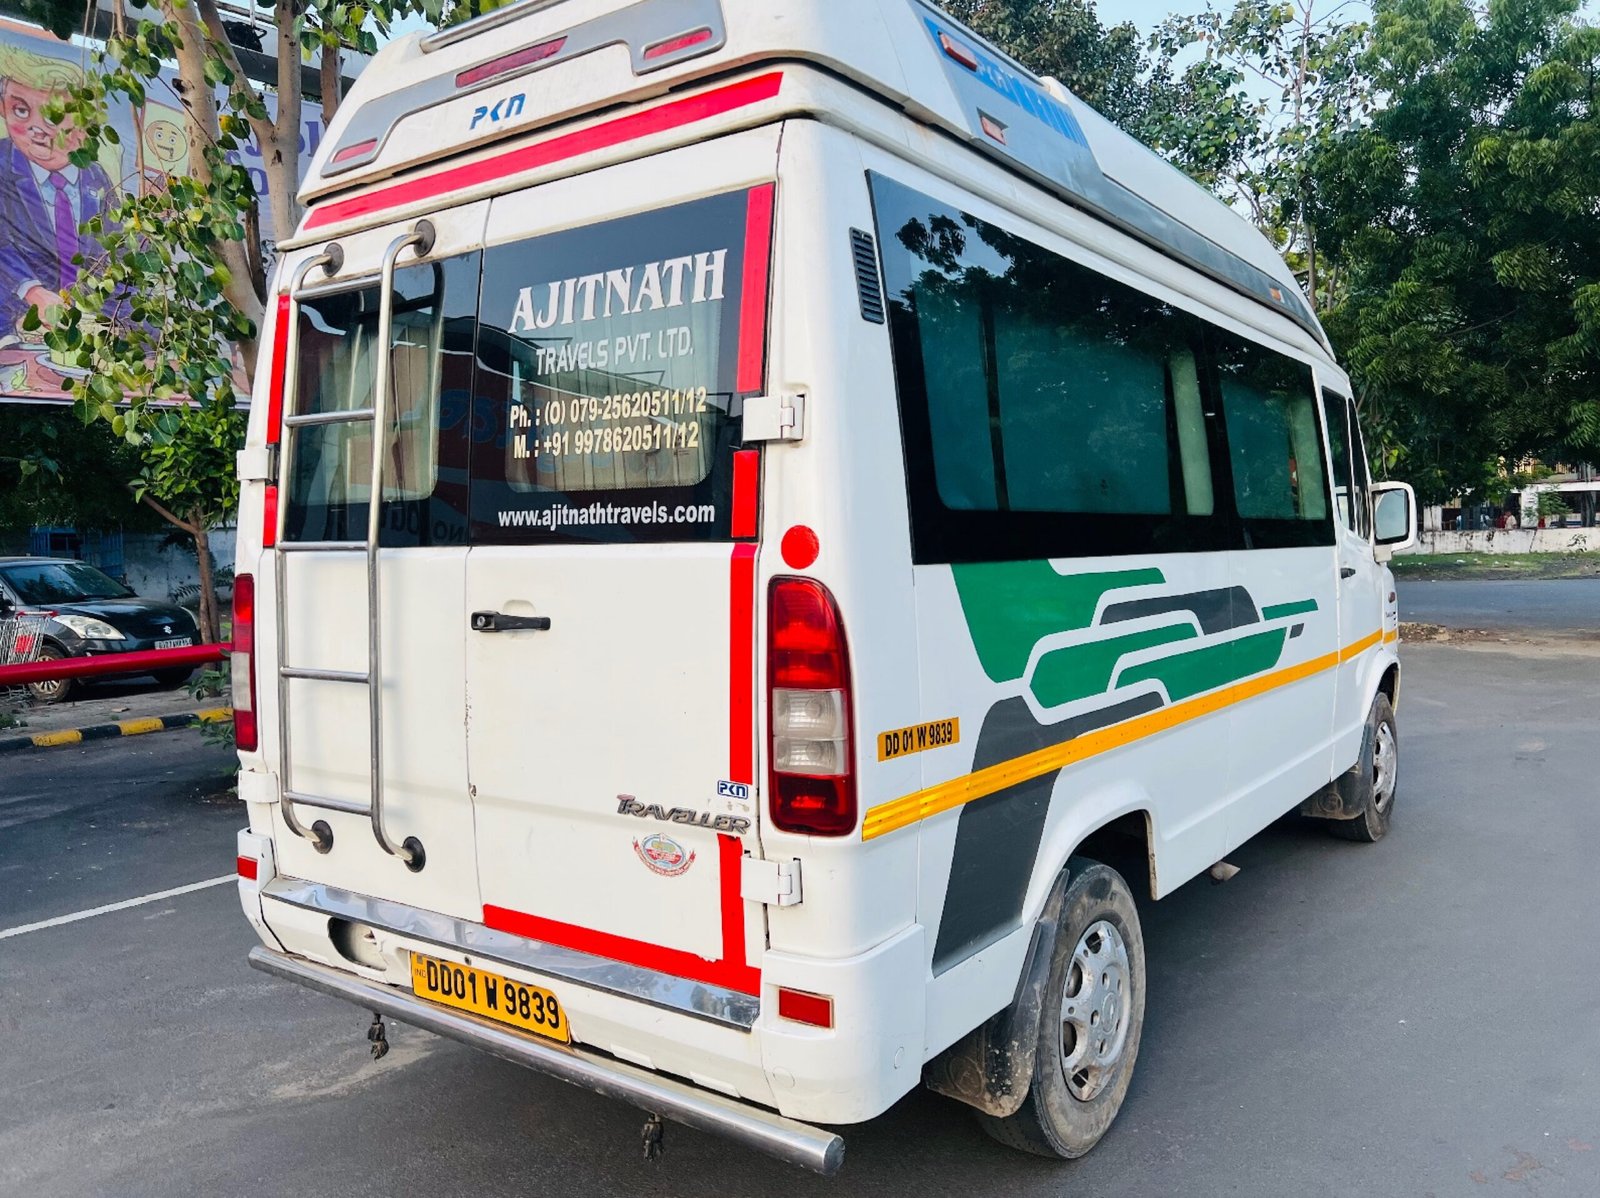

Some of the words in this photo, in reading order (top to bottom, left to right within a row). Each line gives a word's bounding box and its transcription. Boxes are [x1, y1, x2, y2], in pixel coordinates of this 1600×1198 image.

[507, 249, 727, 333] AJITNATH
[535, 337, 609, 376] TRAVELS
[615, 332, 651, 364] PVT.
[658, 326, 694, 357] LTD.
[510, 404, 531, 428] Ph.
[570, 386, 707, 423] 079-25620511/12
[514, 434, 530, 458] M.
[544, 431, 569, 456] +91
[575, 421, 699, 454] 9978620511/12
[498, 501, 716, 531] www.ajitnathtravels.com
[885, 733, 899, 757] DD
[903, 729, 913, 752] 01
[917, 725, 927, 748] W
[929, 722, 953, 745] 9839
[426, 960, 477, 1004] DD01
[485, 975, 498, 1010] W
[504, 983, 560, 1029] 9839
